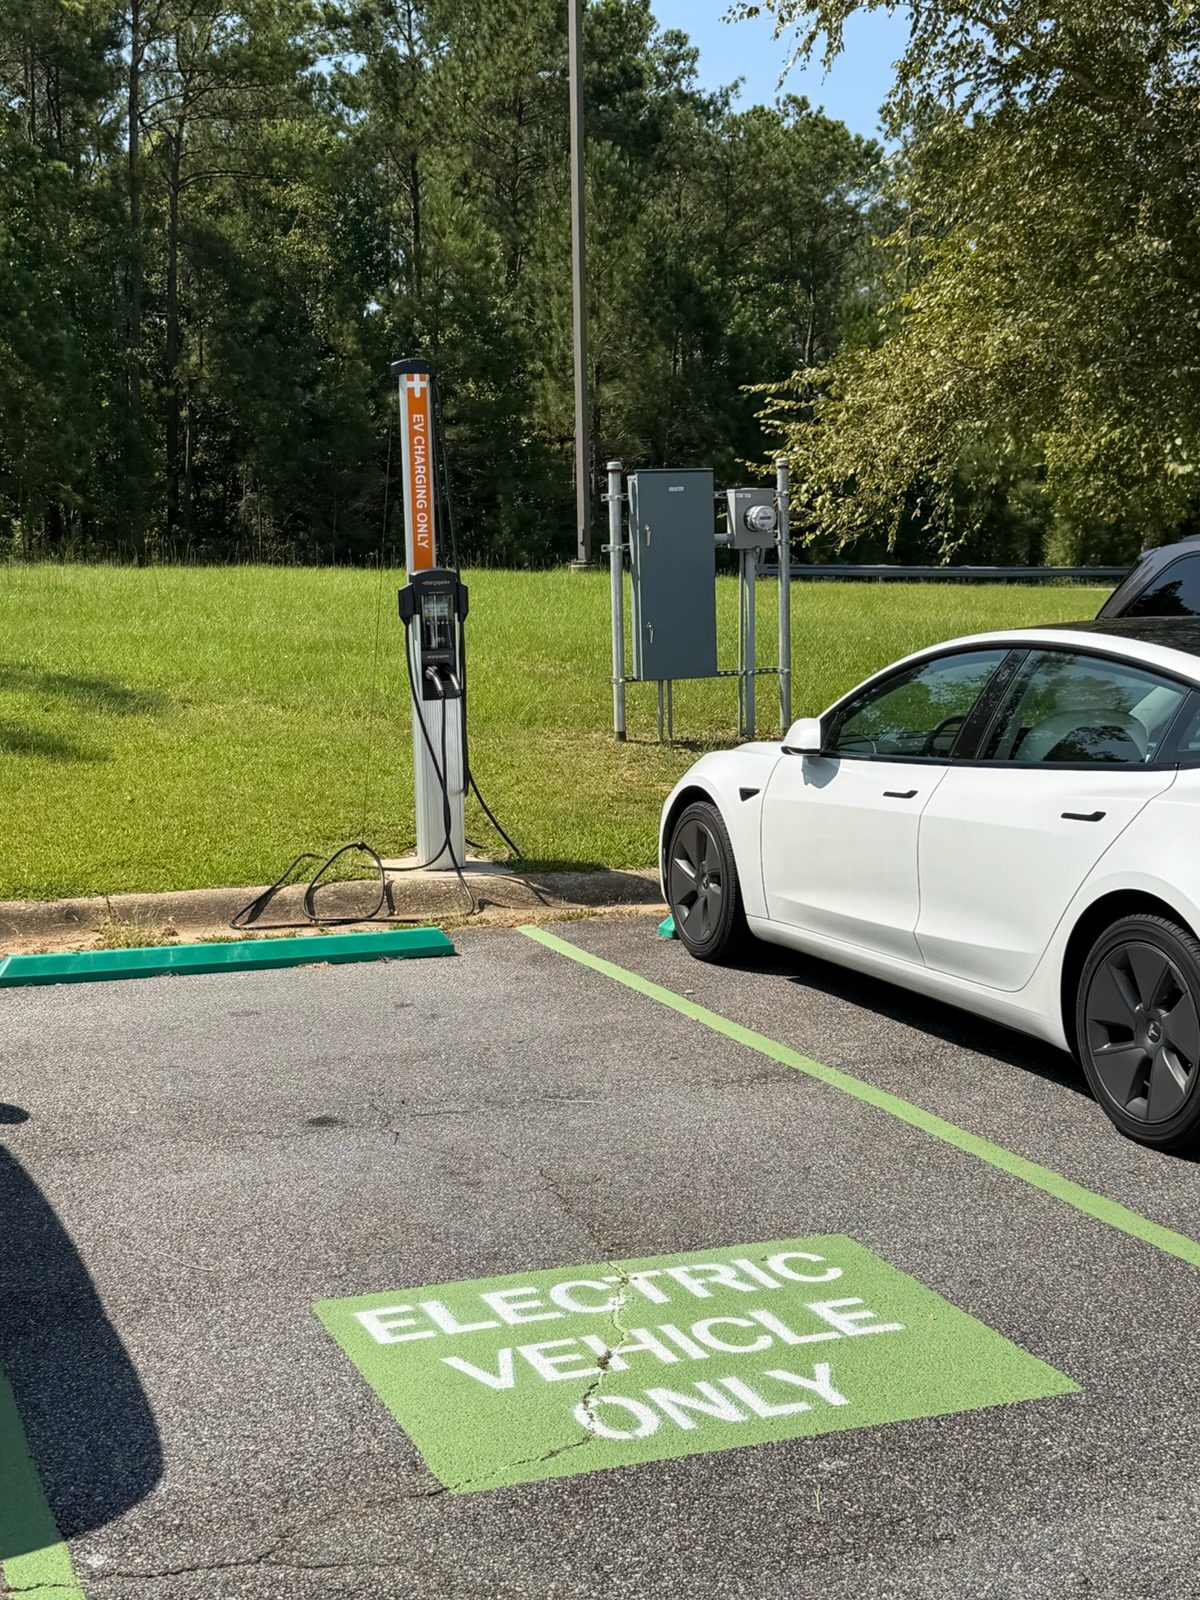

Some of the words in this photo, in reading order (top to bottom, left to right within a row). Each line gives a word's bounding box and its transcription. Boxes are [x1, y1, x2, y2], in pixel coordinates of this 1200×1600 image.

[413, 414, 424, 431] EV
[414, 436, 427, 508] CHARGING
[417, 512, 428, 548] ONLY
[353, 1250, 844, 1346] ELECTRIC
[441, 1297, 906, 1392] VEHICLE
[574, 1362, 851, 1441] ONLY
